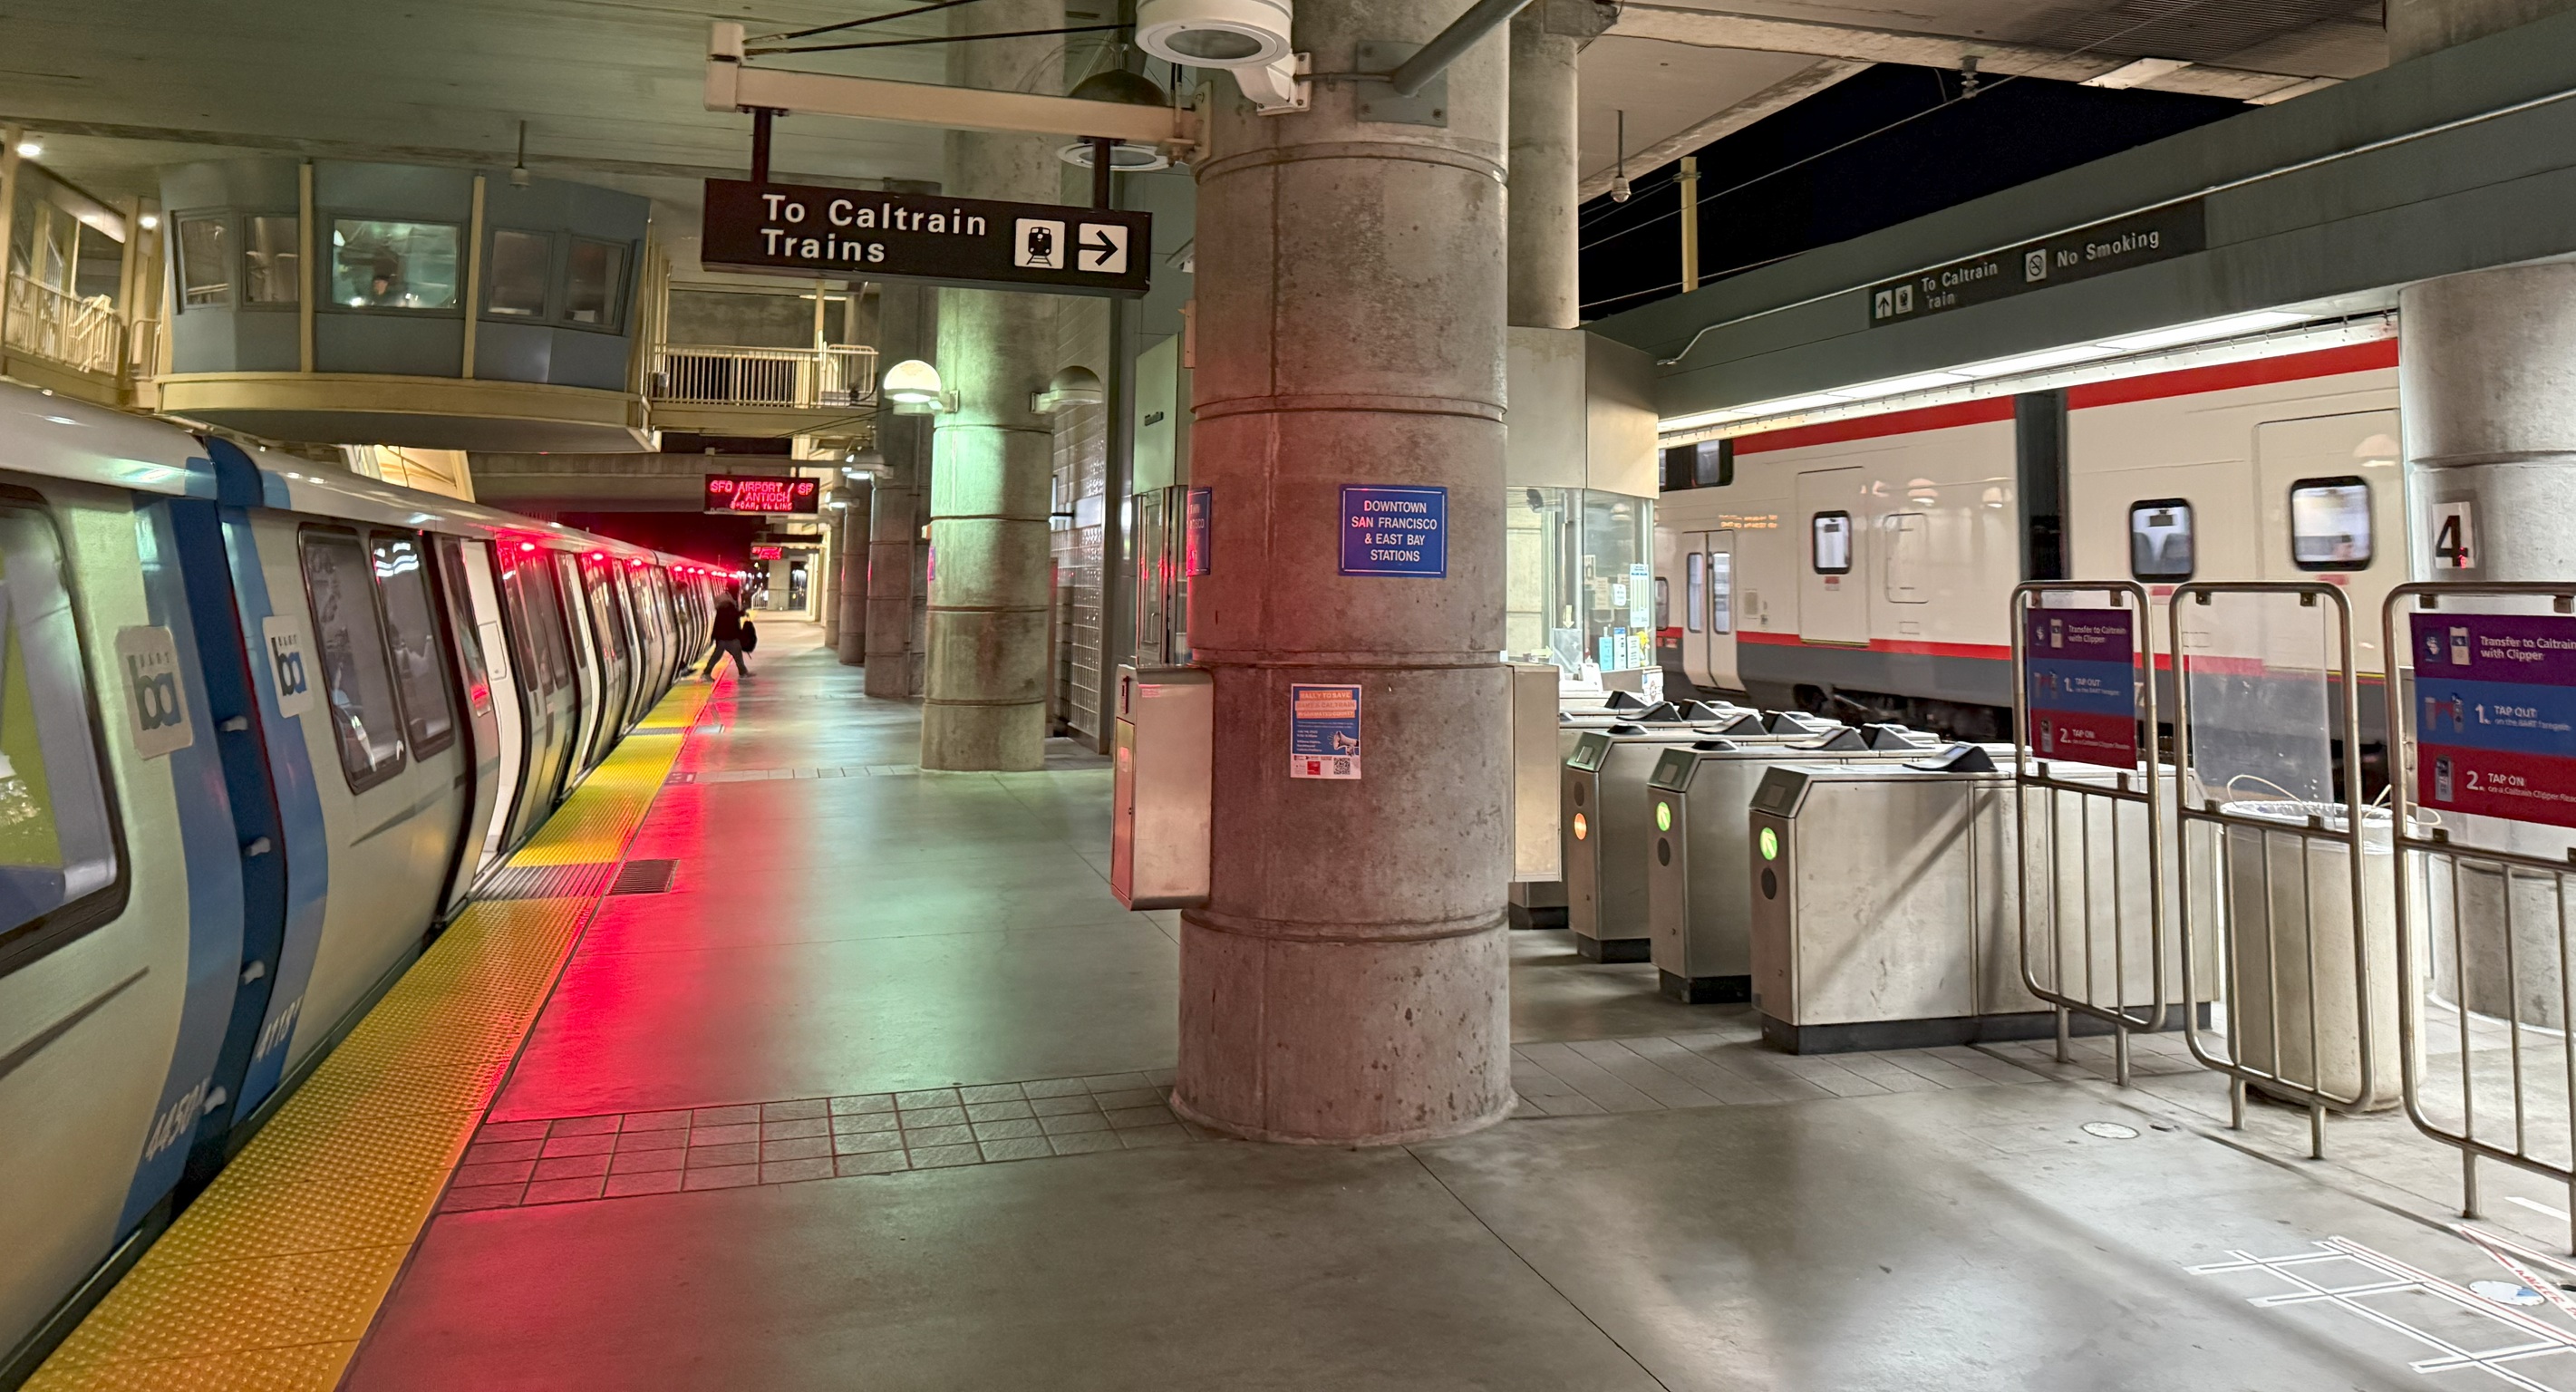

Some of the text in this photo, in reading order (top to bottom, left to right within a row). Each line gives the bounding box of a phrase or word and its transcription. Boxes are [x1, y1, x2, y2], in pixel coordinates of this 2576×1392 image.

[762, 194, 986, 236] To Caltrain
[760, 228, 885, 263] Trains
[2057, 230, 2159, 268] No Smoking
[1921, 261, 1999, 293] To Caltrain
[710, 480, 732, 493] SFO
[739, 481, 783, 493] AIRPORT
[745, 492, 790, 502] ANTIOCH
[1363, 500, 1427, 514] DOWNTOWN
[1351, 516, 1438, 530] SAN FRANCISCO
[1364, 533, 1426, 546] & EAST BAY
[2436, 515, 2468, 567] 4
[1370, 549, 1420, 562] STATIONS
[2480, 635, 2576, 650] Transfer to Caltrain
[2480, 648, 2544, 662] with Clipper
[2474, 703, 2537, 724] 1. TAP OUT
[2466, 770, 2525, 791] 2. TAP ON
